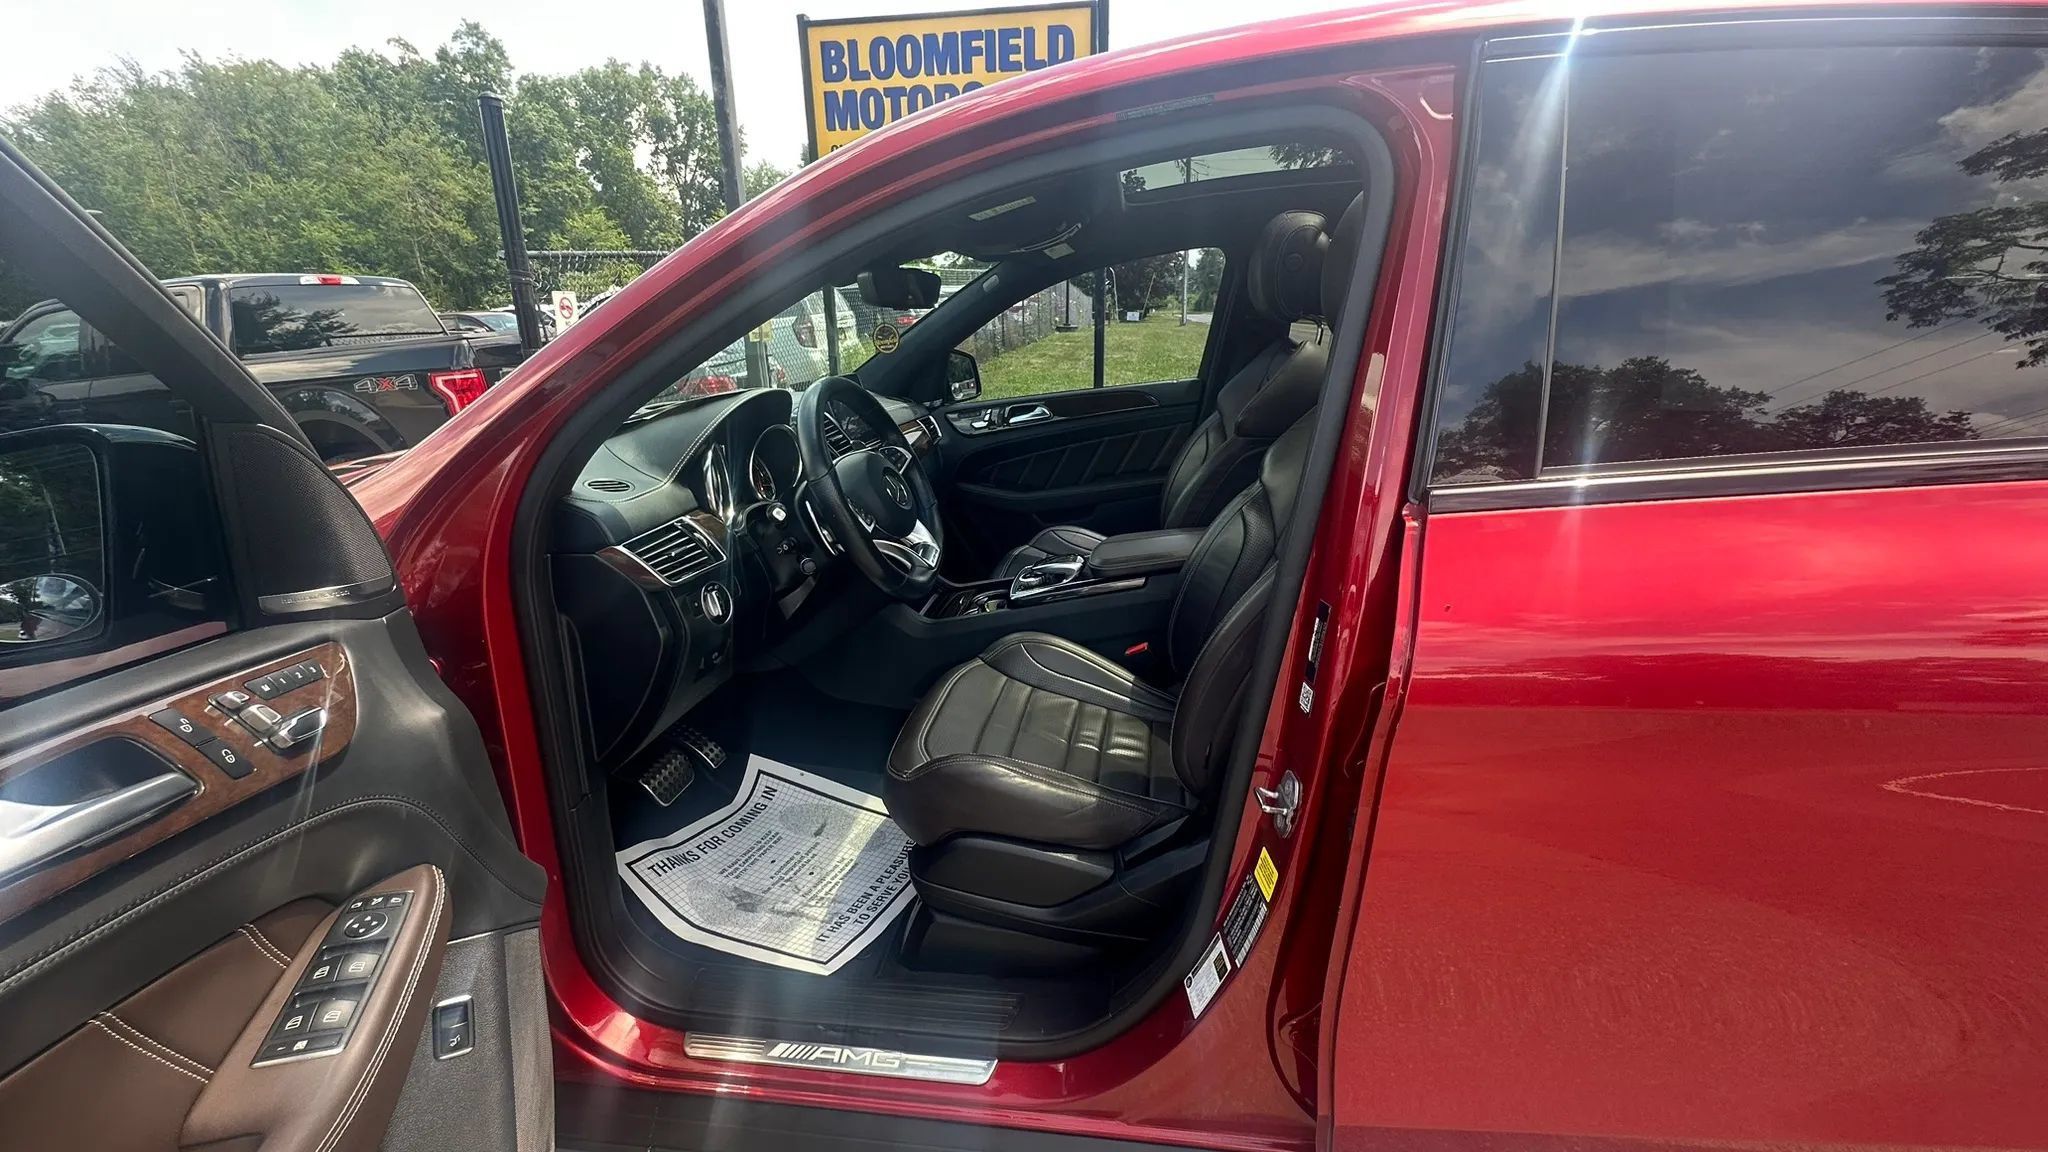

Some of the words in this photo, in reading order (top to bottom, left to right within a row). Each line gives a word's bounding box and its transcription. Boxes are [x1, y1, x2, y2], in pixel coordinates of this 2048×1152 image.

[820, 24, 1075, 83] BLOOMFIELD
[823, 82, 984, 131] MOTO
[647, 850, 701, 877] THANKS
[696, 835, 726, 854] FOR
[721, 802, 768, 838] COMING
[761, 785, 777, 801] IN
[816, 933, 830, 942] IT
[827, 914, 851, 933] HAS
[846, 892, 873, 914] BEEN
[869, 884, 880, 892] A
[875, 839, 916, 885] PLEASURE
[853, 913, 871, 925] TO
[866, 885, 898, 912] SERVE
[808, 1046, 900, 1068] AMG
